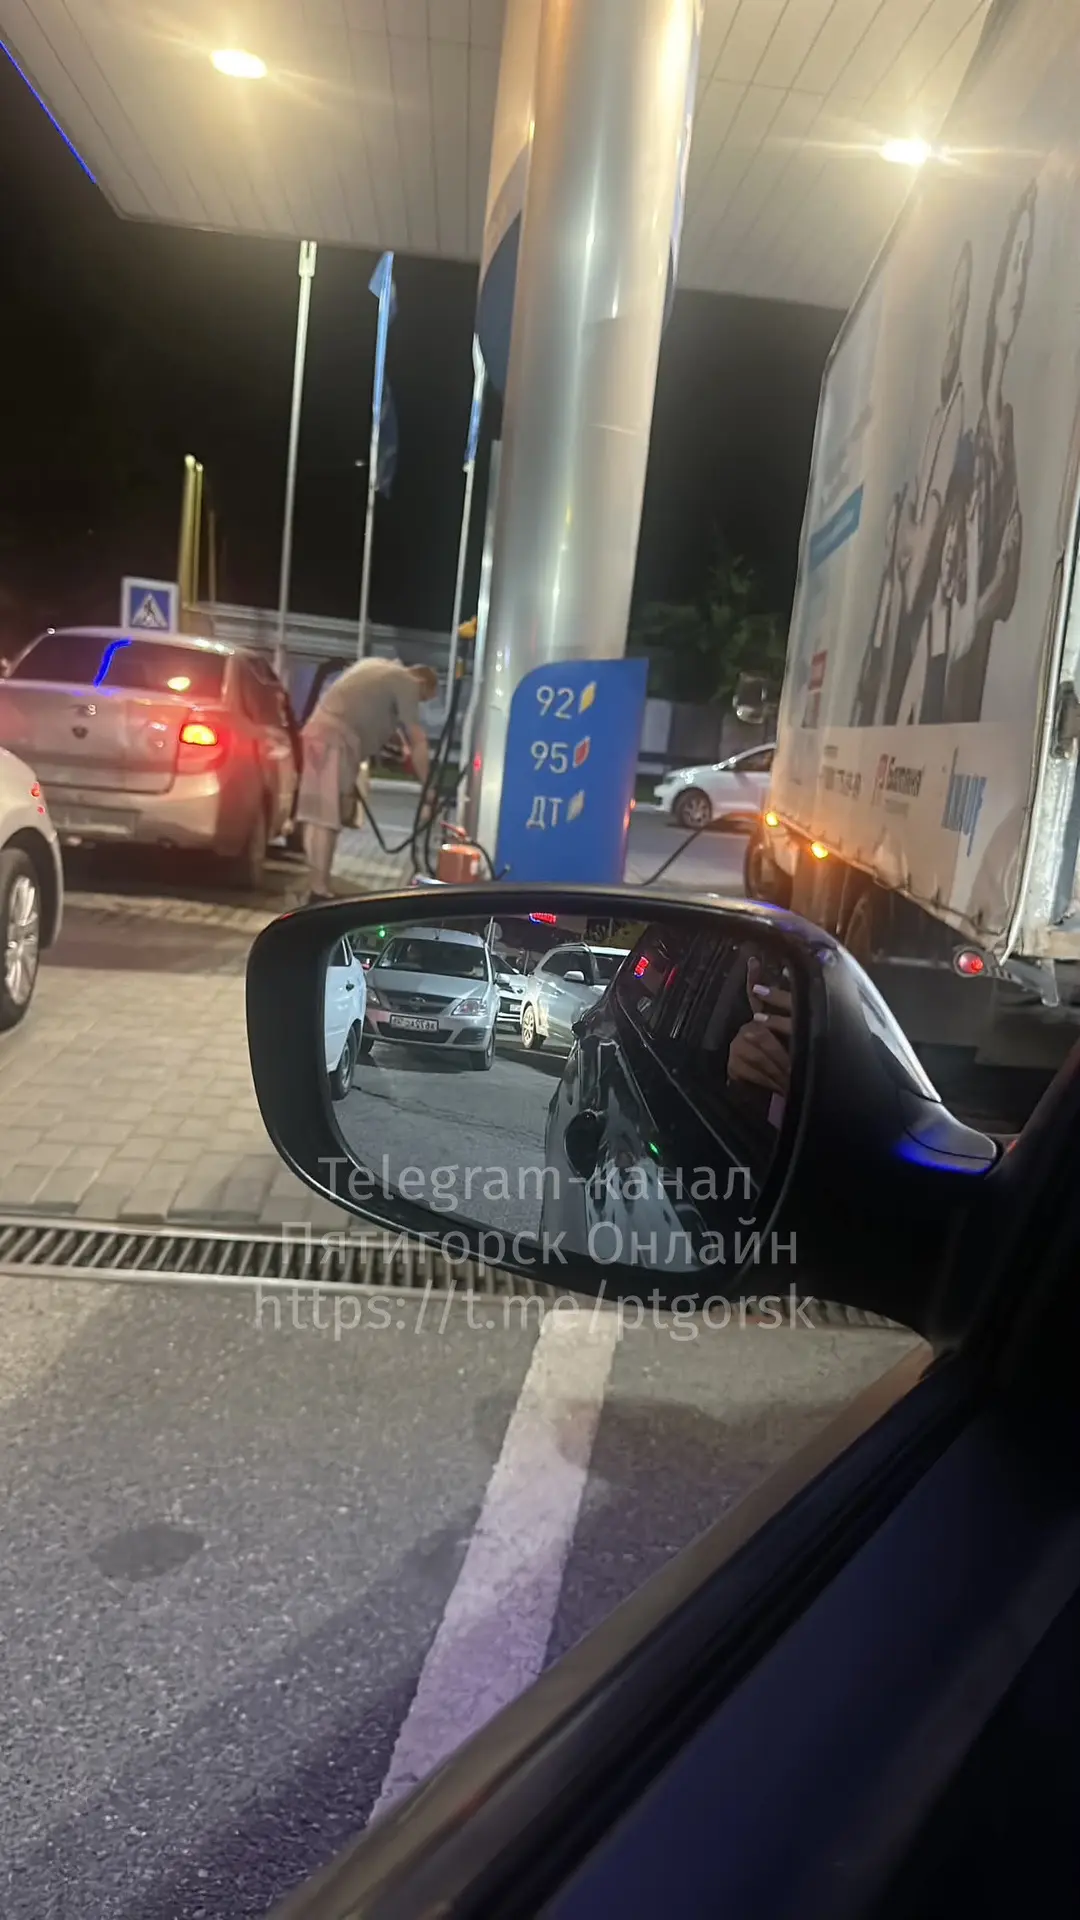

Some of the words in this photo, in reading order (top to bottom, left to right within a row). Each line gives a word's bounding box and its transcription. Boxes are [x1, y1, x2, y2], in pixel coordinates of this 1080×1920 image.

[536, 685, 575, 720] 92
[530, 740, 569, 774] 95
[525, 795, 564, 830] ДТ
